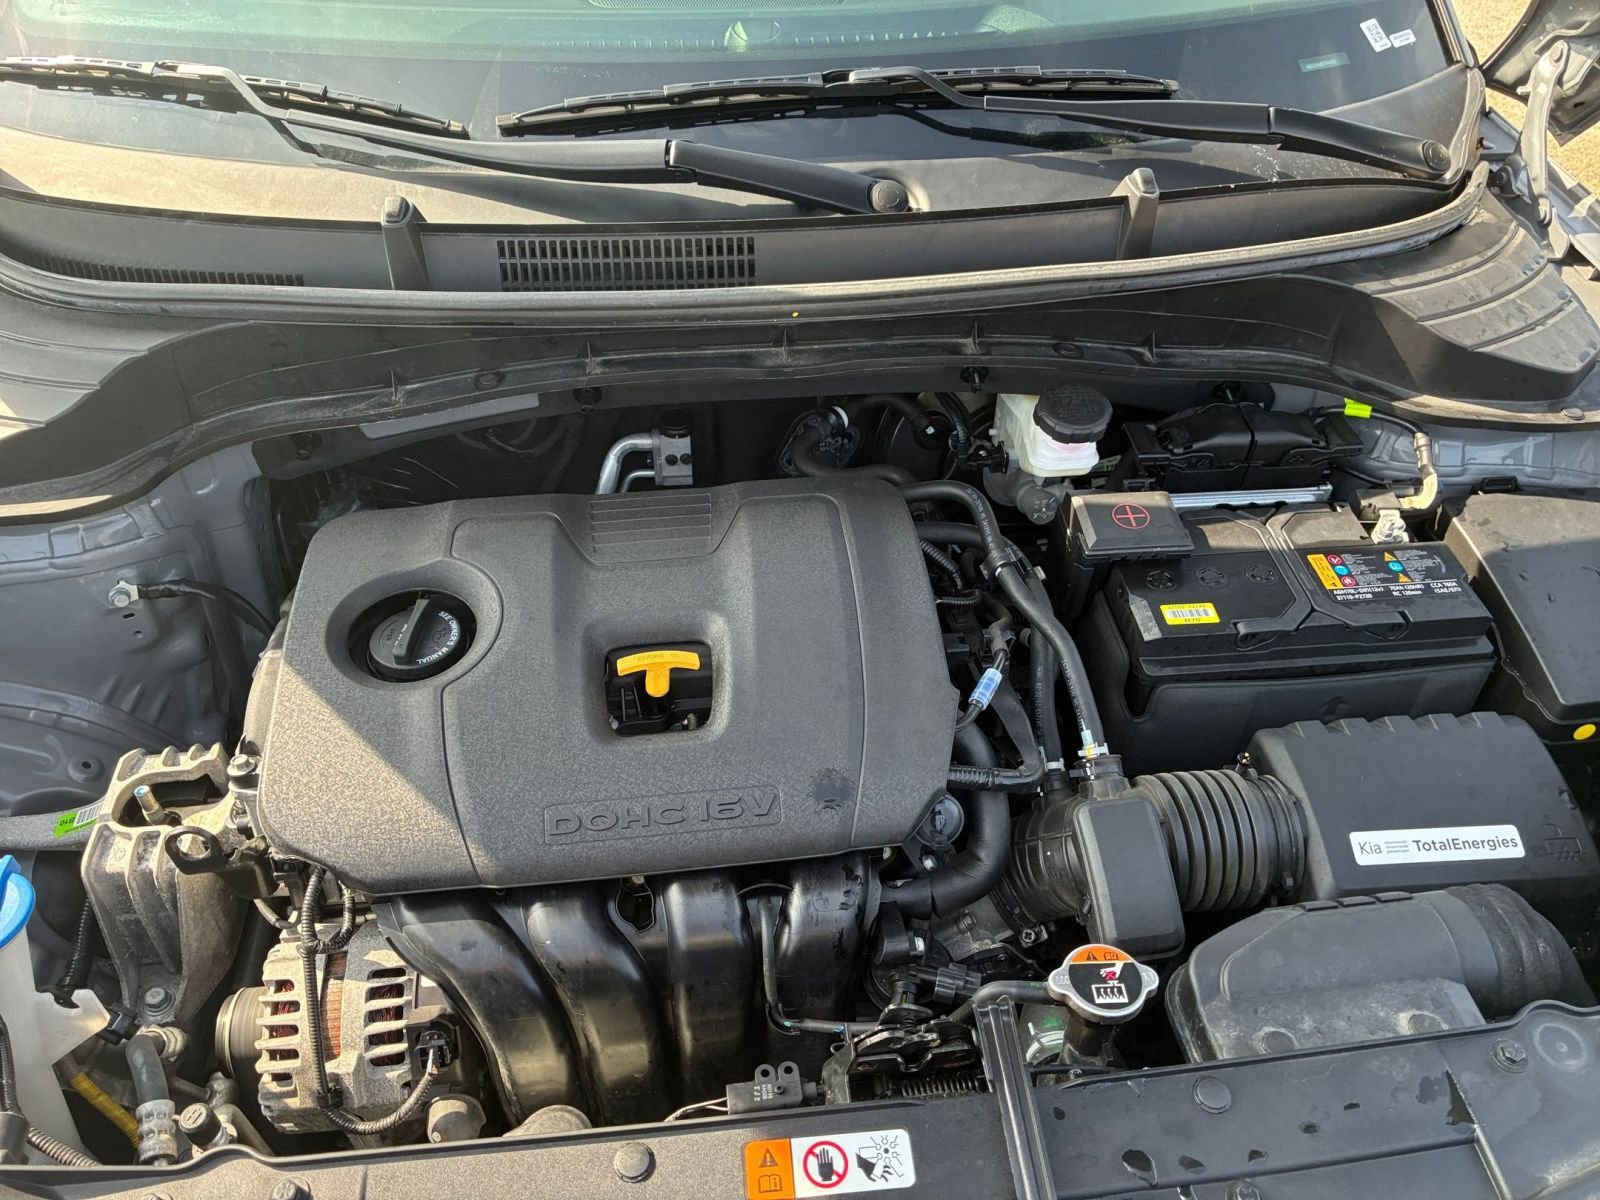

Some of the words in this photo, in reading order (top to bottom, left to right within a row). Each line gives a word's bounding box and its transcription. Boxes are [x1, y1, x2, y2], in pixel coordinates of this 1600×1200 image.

[438, 611, 453, 621] SEE
[447, 620, 459, 646] OWNER'S
[416, 646, 449, 664] MANUAL
[549, 804, 686, 836] DOHC
[698, 792, 777, 822] 16V
[1358, 841, 1382, 855] Kia
[1412, 835, 1518, 852] TotalEnergies
